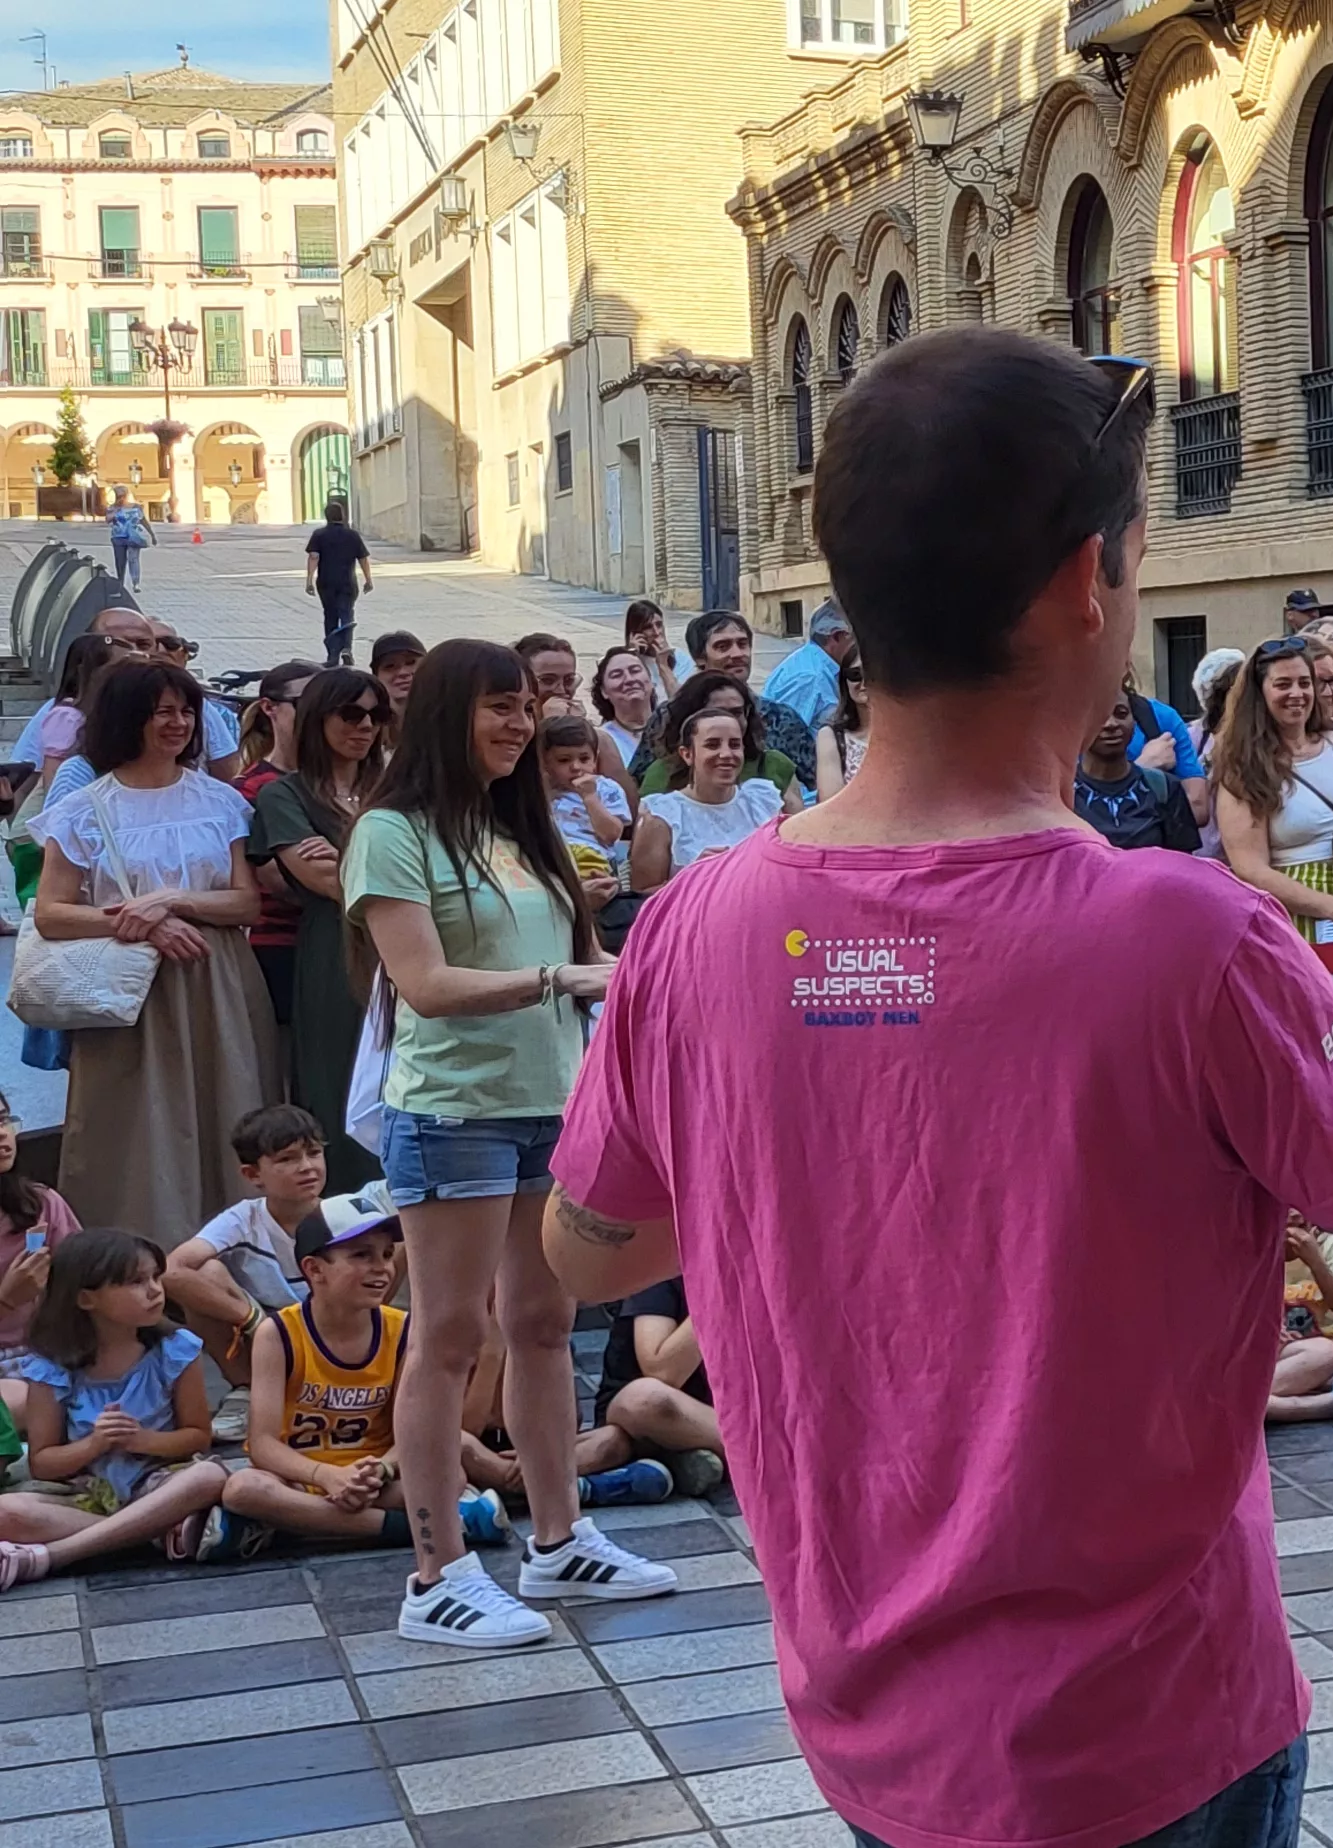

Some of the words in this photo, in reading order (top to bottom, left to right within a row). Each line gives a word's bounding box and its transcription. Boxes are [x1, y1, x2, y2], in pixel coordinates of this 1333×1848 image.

[826, 949, 904, 972] USUAL
[793, 975, 925, 996] SUSPECTS
[882, 1010, 920, 1025] MEN
